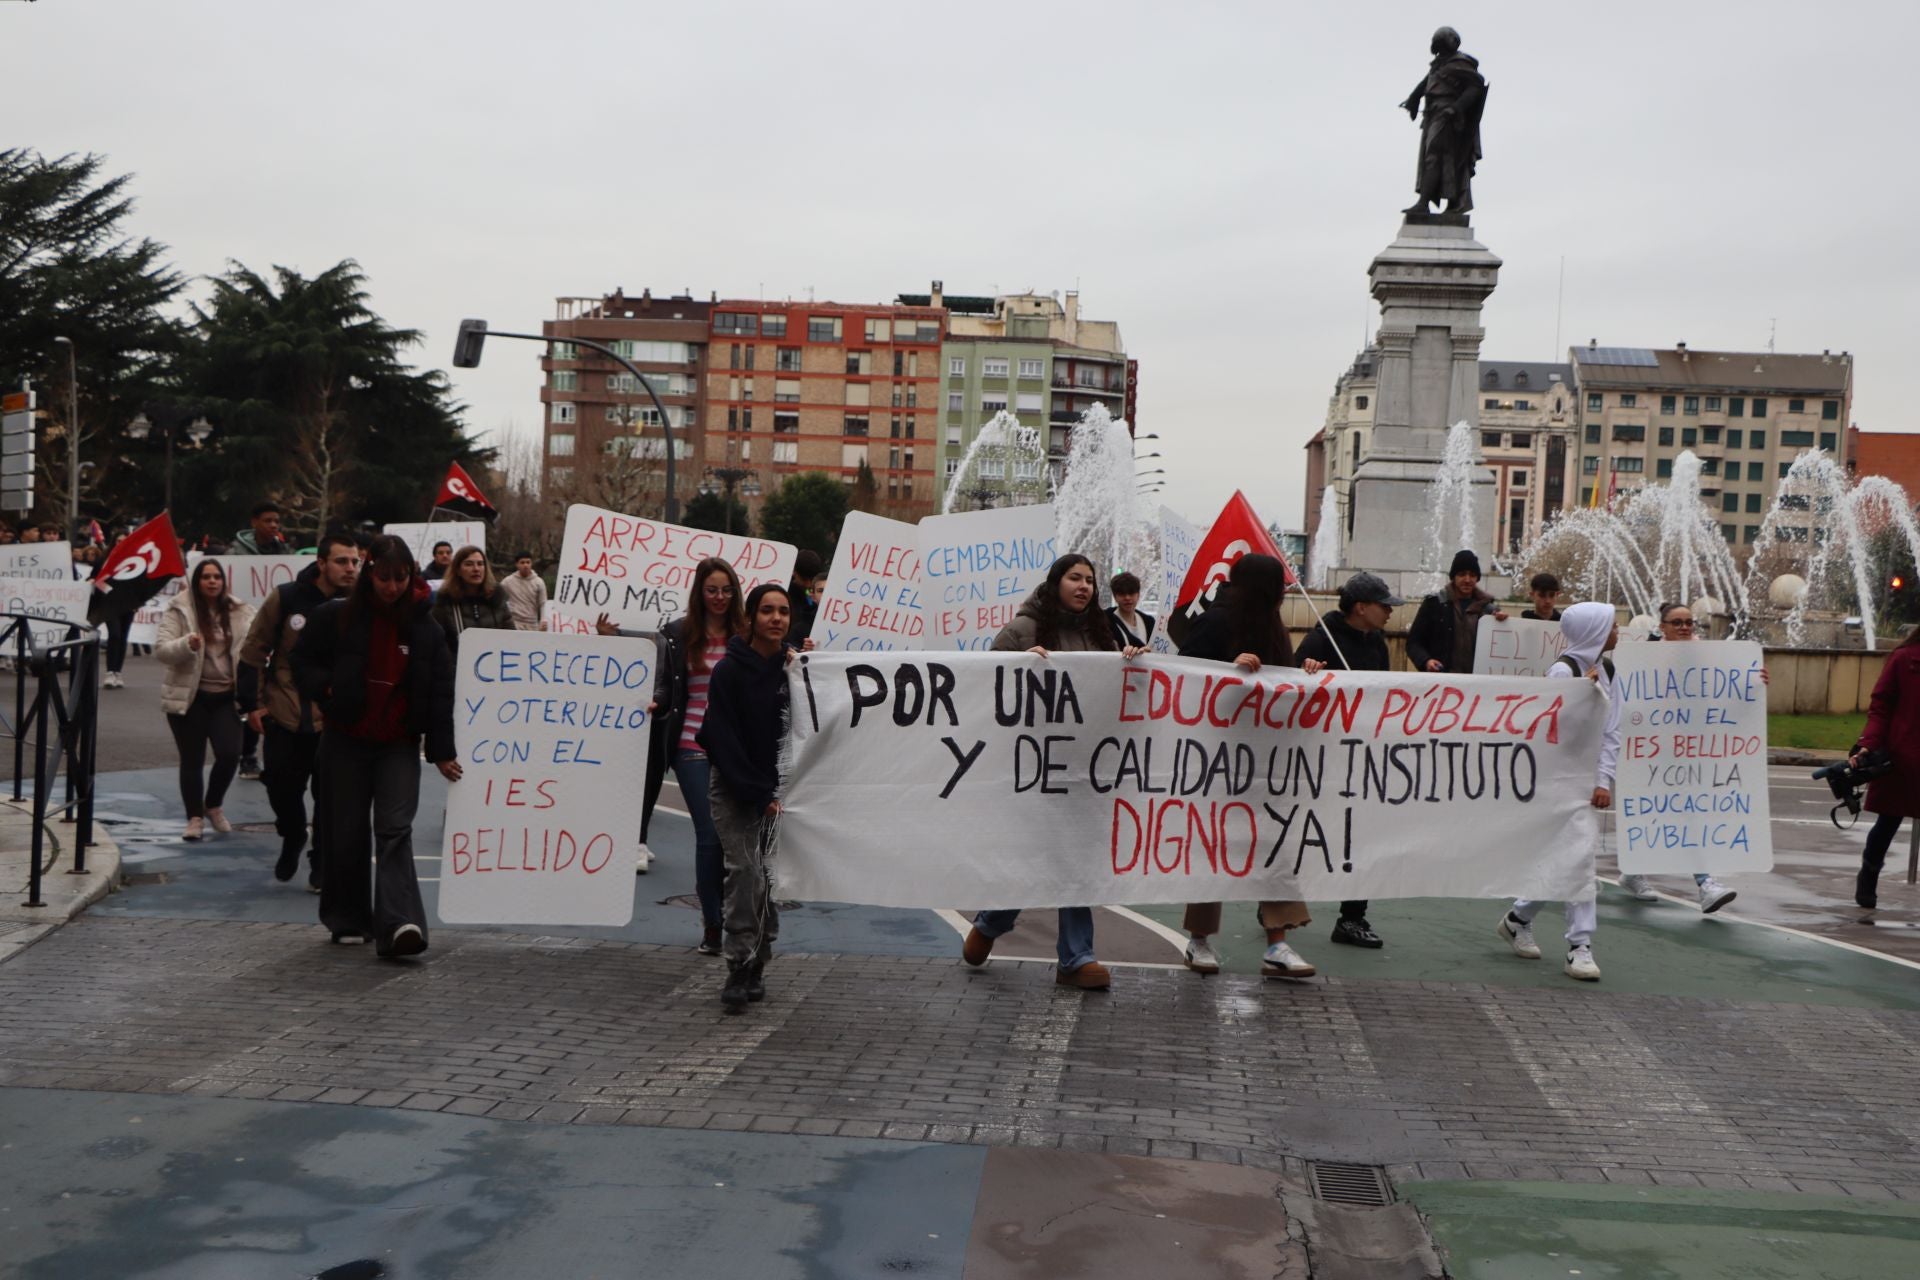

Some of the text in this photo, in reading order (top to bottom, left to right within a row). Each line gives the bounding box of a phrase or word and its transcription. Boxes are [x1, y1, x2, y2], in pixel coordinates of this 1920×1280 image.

[583, 515, 778, 571] ARREGLAD
[927, 537, 1057, 577] CEMBRANOS
[578, 548, 629, 578] LAS
[623, 586, 679, 613] MÁS
[846, 577, 923, 609] CON EL
[943, 577, 1025, 604] CON EL
[823, 598, 924, 637] IES BELLID
[935, 604, 1014, 636] IES BELL
[824, 629, 840, 649] Y
[1489, 629, 1527, 660] EL
[473, 649, 648, 689] CERECEDO
[1619, 661, 1761, 702] VILLACEDRÉ
[465, 697, 646, 729] Y OTERUELO
[994, 665, 1084, 727] UNA
[1118, 667, 1364, 734] EDUCACIÓN
[1375, 684, 1564, 744] PÚBLICA
[1651, 708, 1737, 725] CON EL
[471, 739, 602, 765] CON EL
[1627, 735, 1760, 760] IES BELLIDO
[938, 735, 1537, 802] Y DE CALIDAD UN INSTITUTO
[1648, 764, 1742, 788] Y CON LA
[485, 778, 558, 809] IES
[1624, 790, 1750, 817] EDUCACIÓN
[453, 828, 613, 875] BELLIDO
[1111, 798, 1257, 878] DIGNO
[1627, 819, 1749, 852] PÚBLICA
